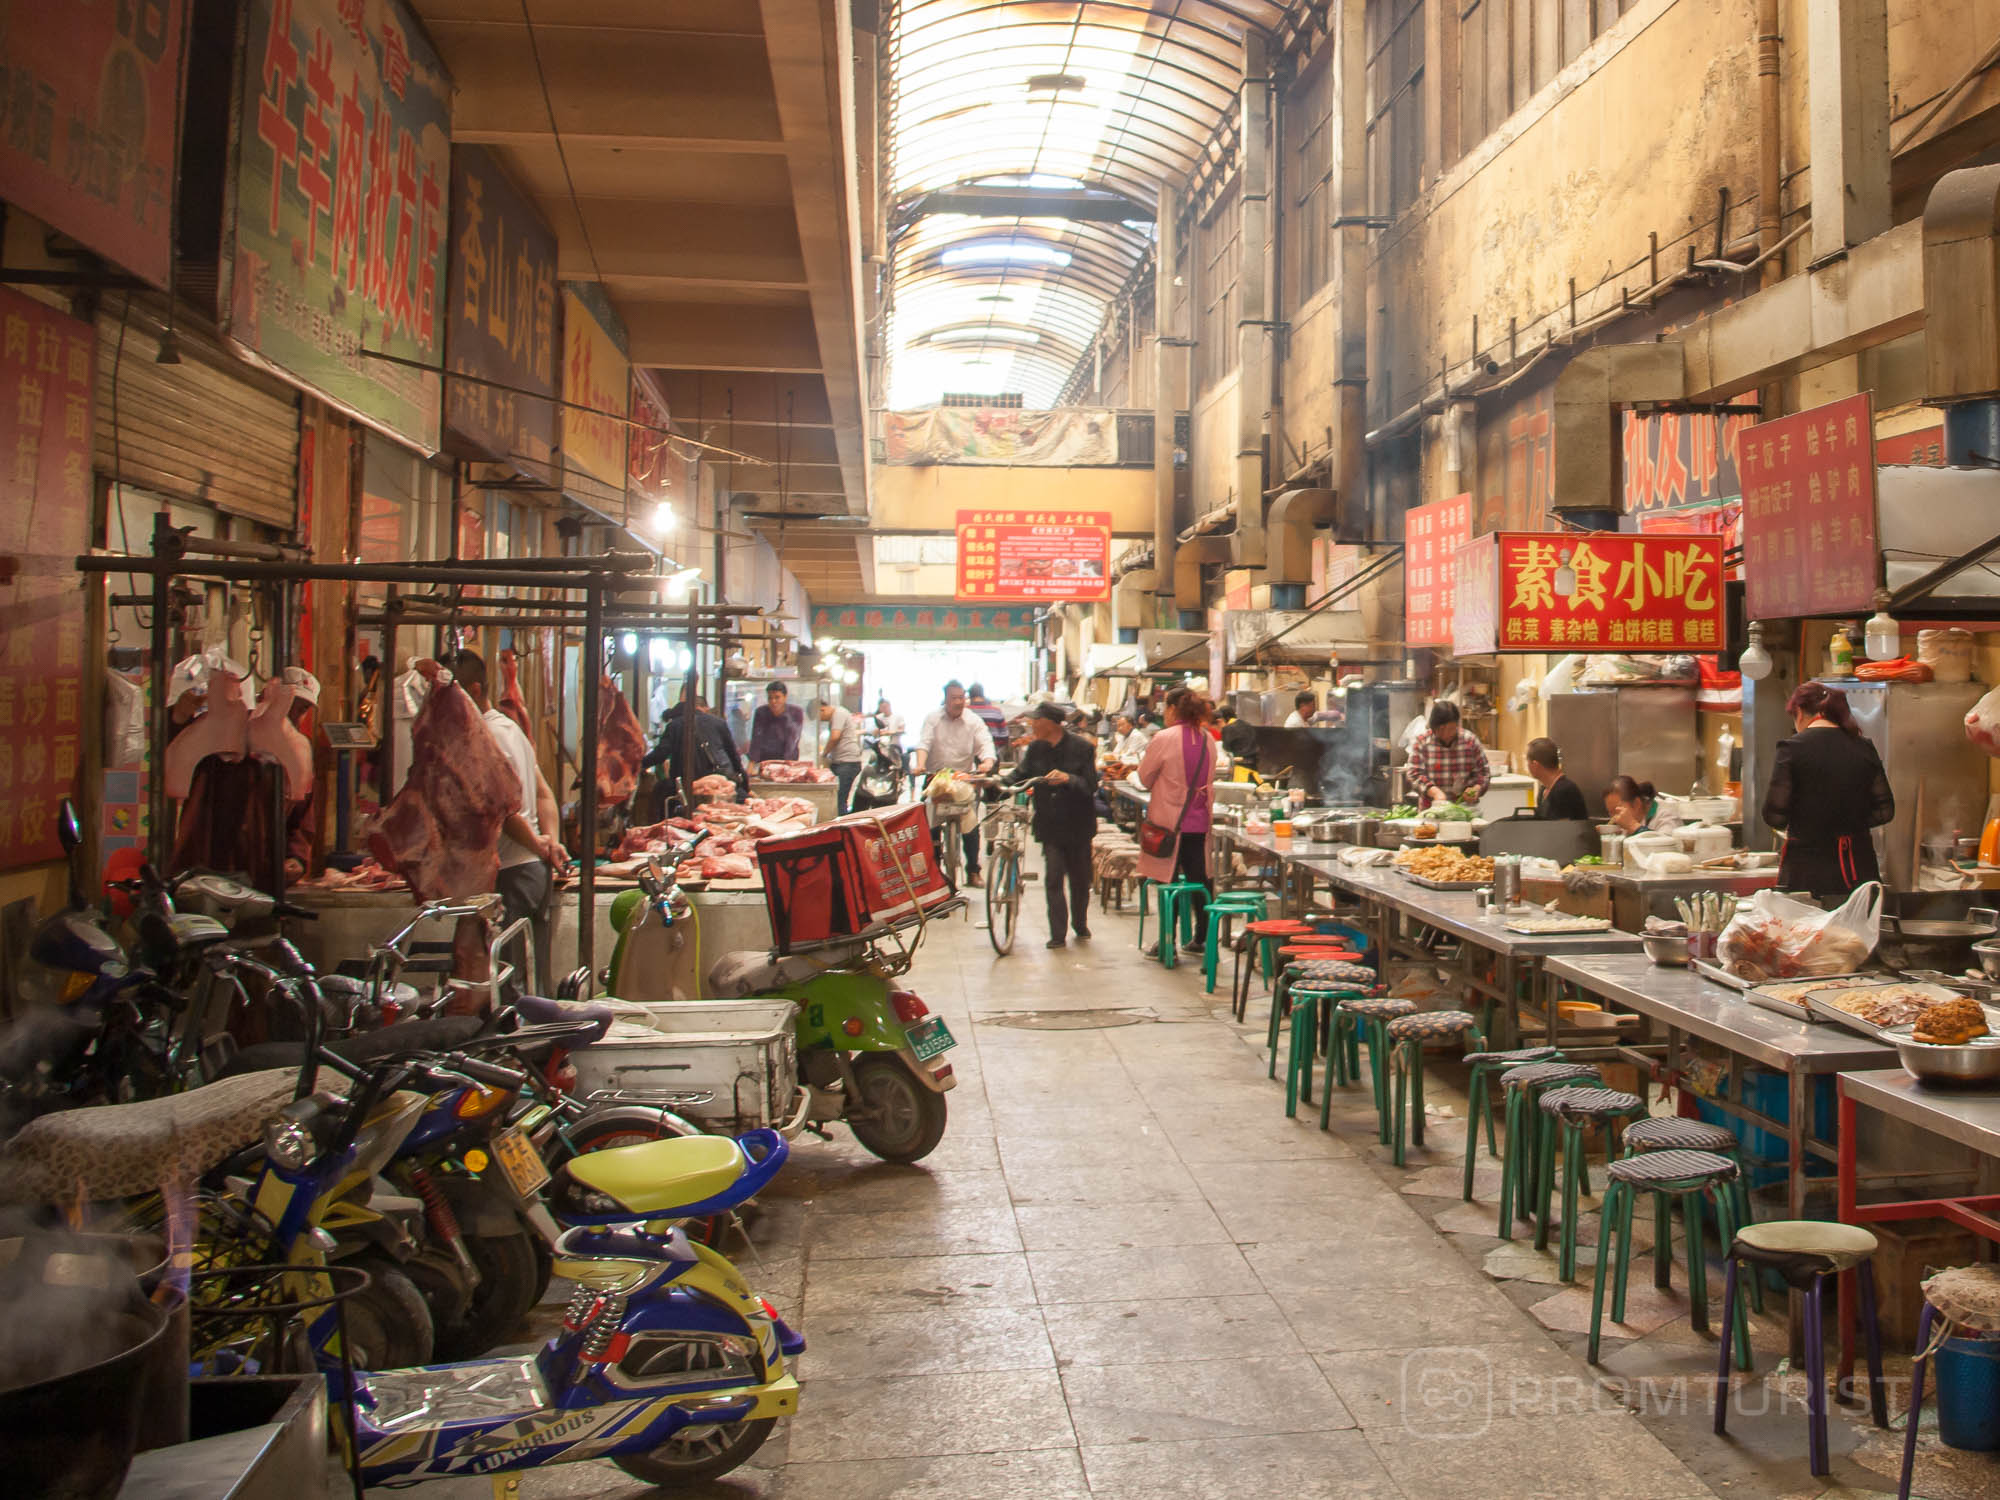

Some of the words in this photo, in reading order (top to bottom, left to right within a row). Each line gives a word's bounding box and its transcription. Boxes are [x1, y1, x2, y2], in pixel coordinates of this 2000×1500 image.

[258, 0, 440, 351] 牛羊肉批发店
[1508, 540, 1716, 612] 素食小吃
[1506, 617, 1540, 641] 供菜
[1550, 617, 1599, 642] 素杂烩
[1608, 618, 1675, 642] 油饼粽糕
[1683, 618, 1716, 642] 糖糕
[472, 1409, 596, 1474] LUXURIOUS
